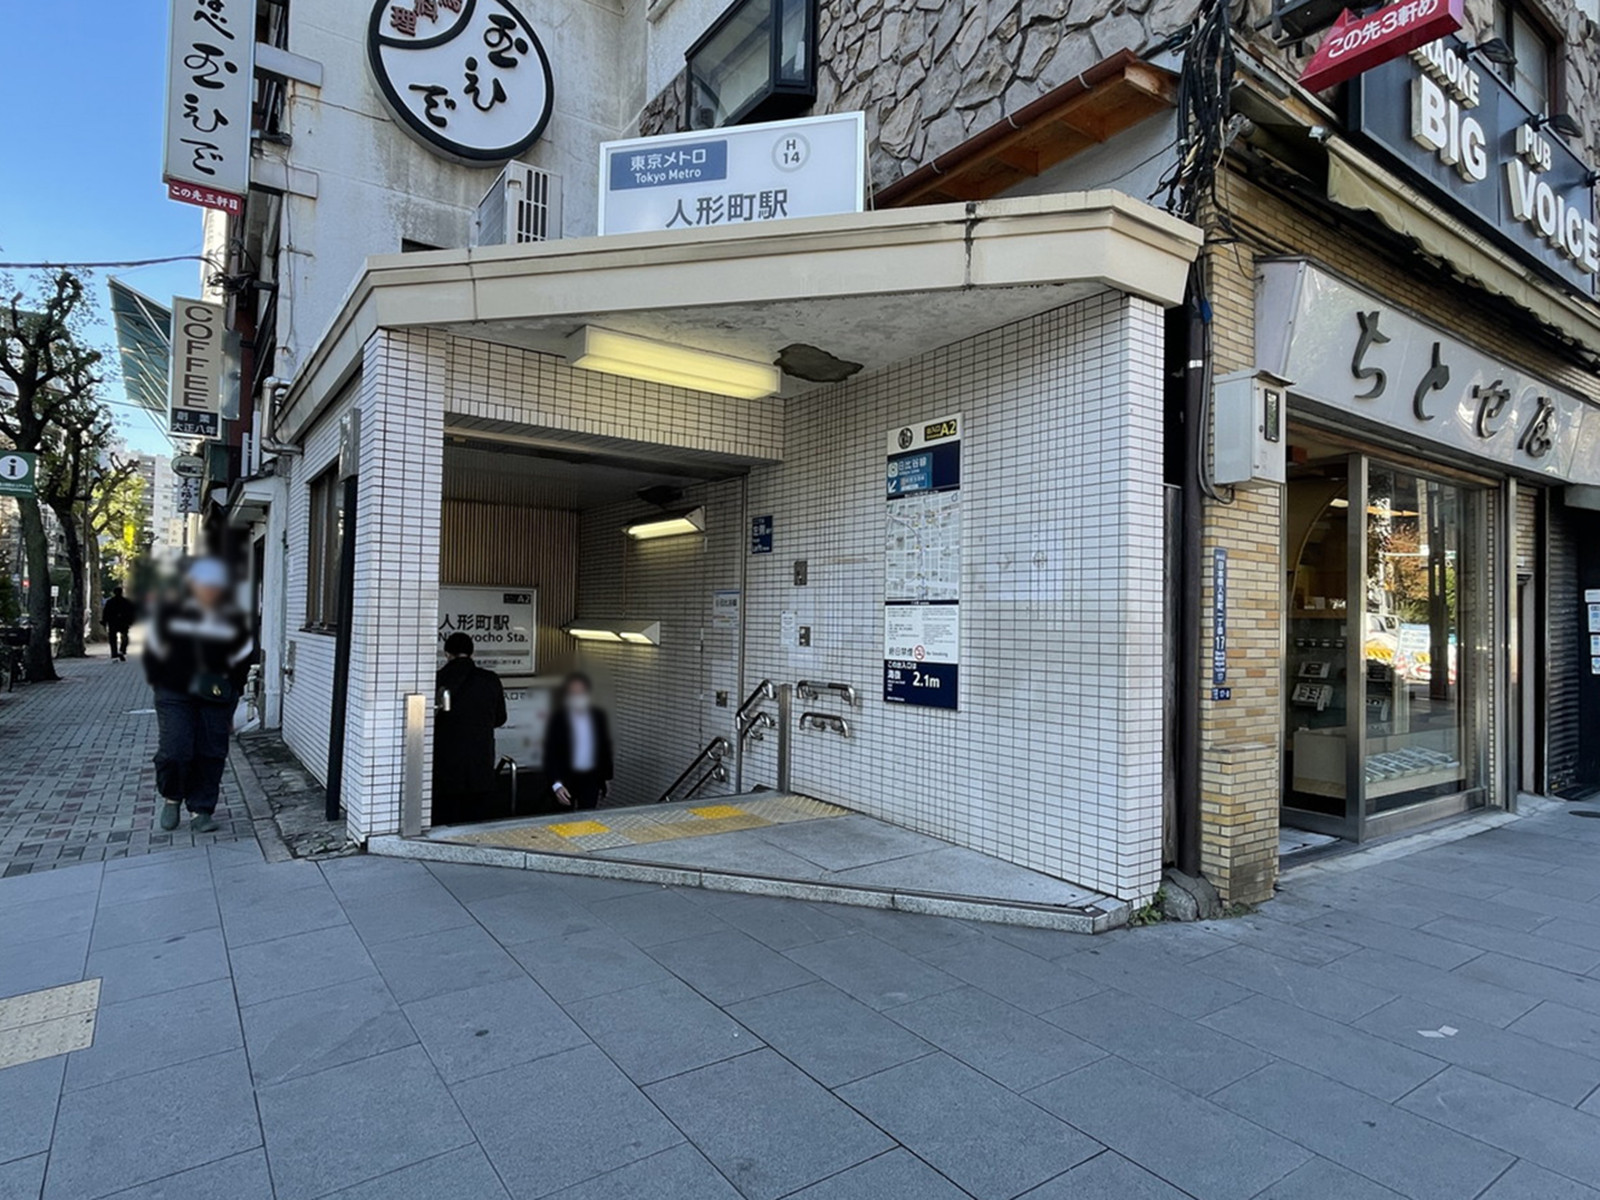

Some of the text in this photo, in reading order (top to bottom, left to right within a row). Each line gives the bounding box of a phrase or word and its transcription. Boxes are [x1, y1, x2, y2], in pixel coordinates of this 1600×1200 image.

[1416, 75, 1487, 182] BIG
[786, 140, 796, 151] H
[1523, 124, 1552, 172] PUB
[630, 149, 707, 172] 東京メトロ
[783, 152, 801, 165] 14
[635, 168, 702, 184] Tokyo Metro
[171, 185, 239, 210] この先三軒目
[665, 189, 788, 228] 人形町駅
[1509, 158, 1600, 273] VOICE
[183, 306, 214, 409] COFFEE
[172, 422, 217, 434] 大正八年
[940, 420, 956, 436] A2
[438, 614, 510, 631] 人形町駅
[507, 632, 529, 643] Sta.
[1215, 637, 1226, 650] 17
[912, 671, 941, 688] 2.1m
